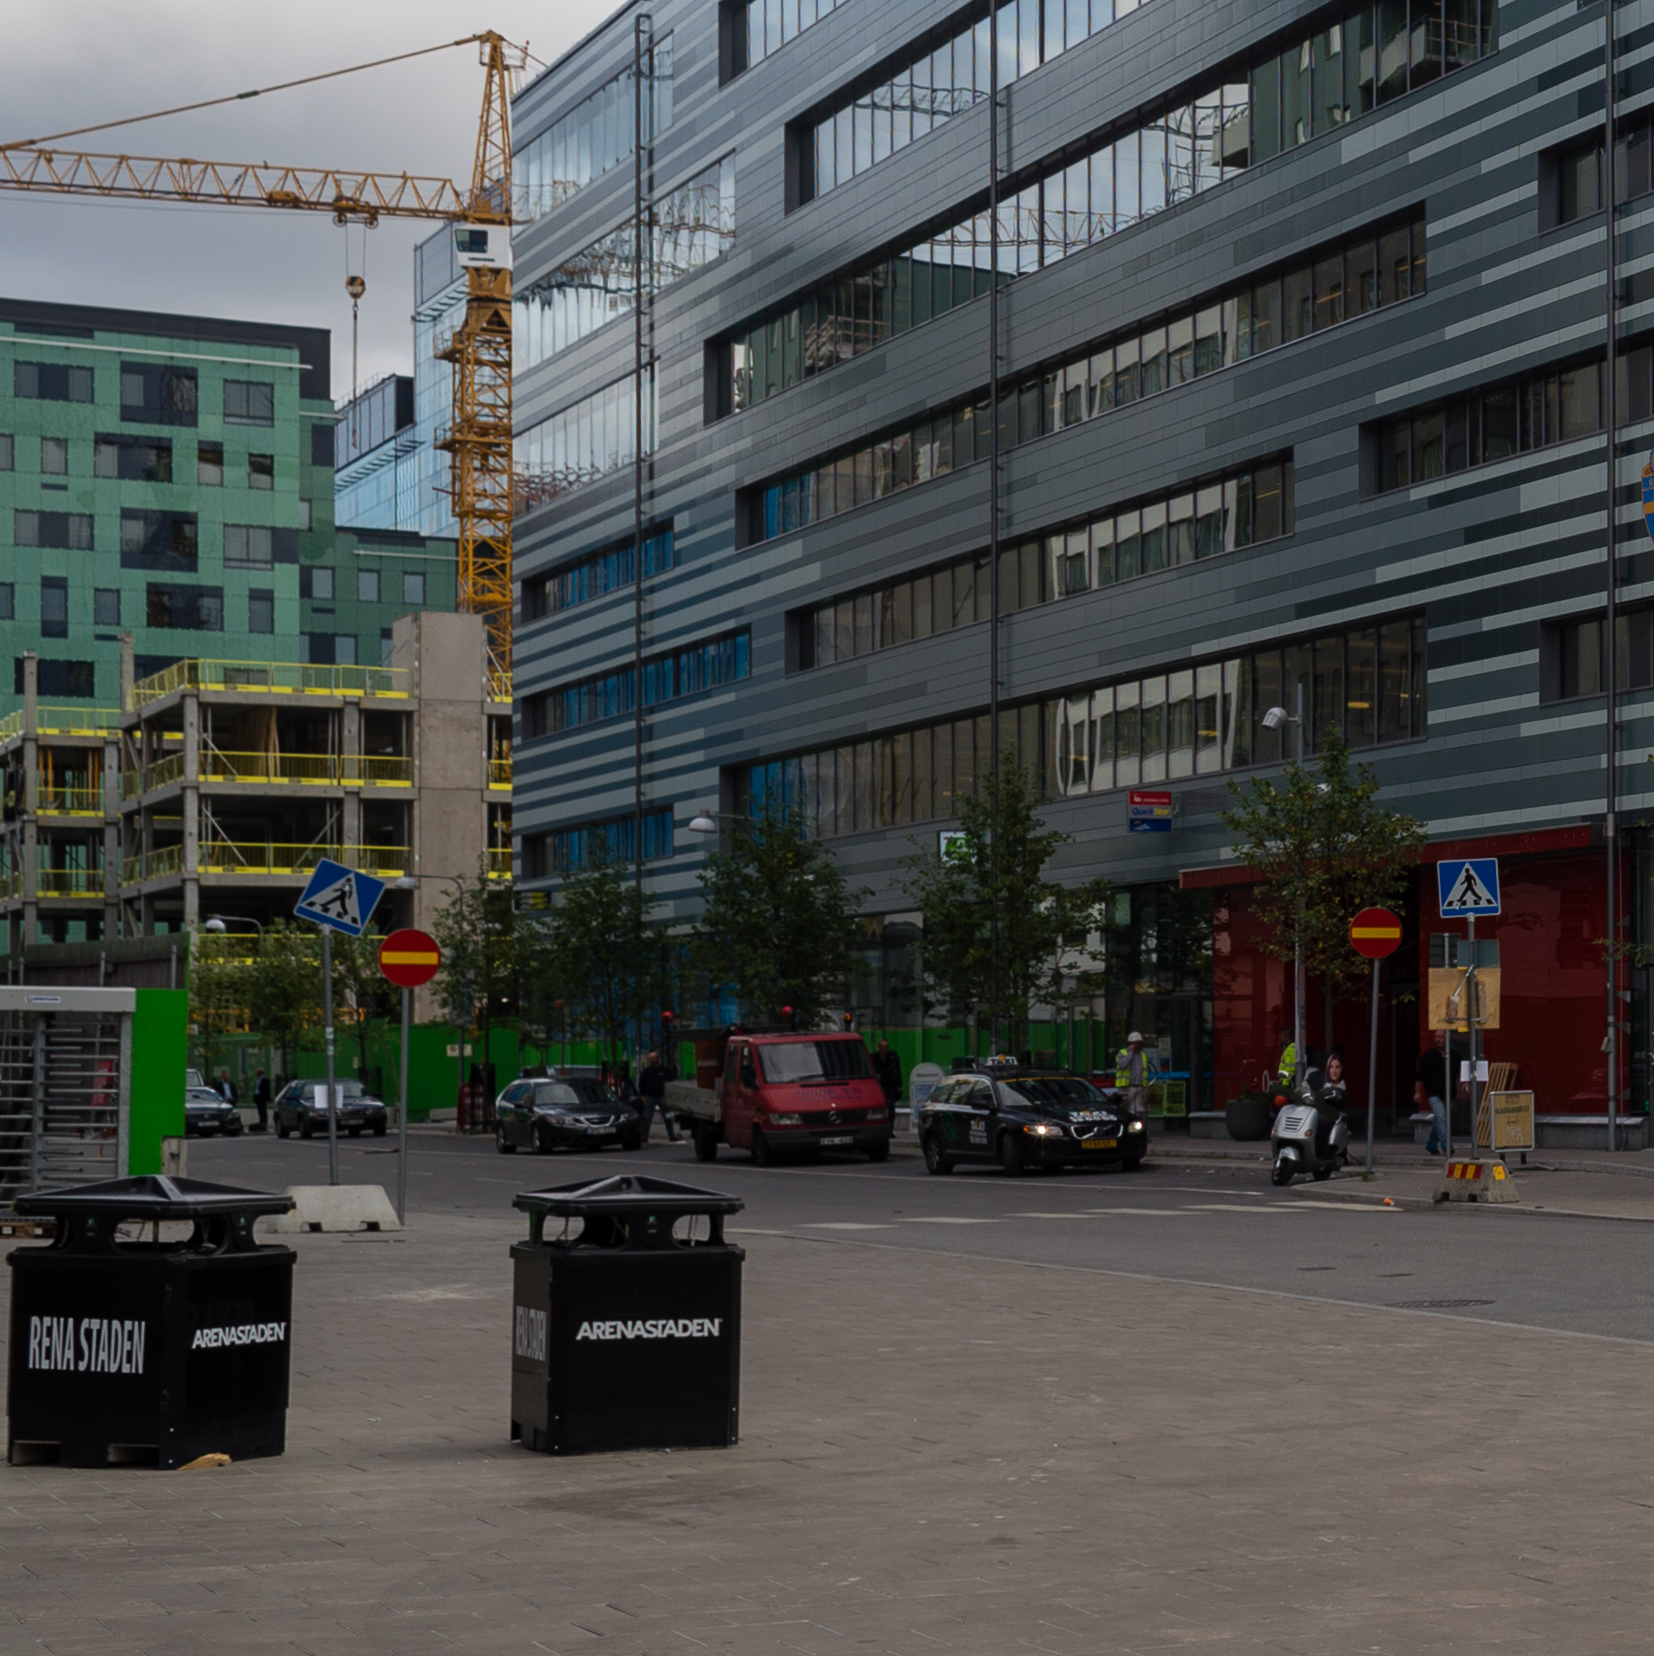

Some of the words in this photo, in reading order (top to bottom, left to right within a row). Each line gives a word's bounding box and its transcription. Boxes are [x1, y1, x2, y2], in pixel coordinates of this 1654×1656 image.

[191, 1322, 287, 1350] ARENASTADEN
[575, 1317, 722, 1341] ARENASTADEN
[28, 1316, 75, 1371] RENA
[77, 1317, 146, 1375] STADEN
